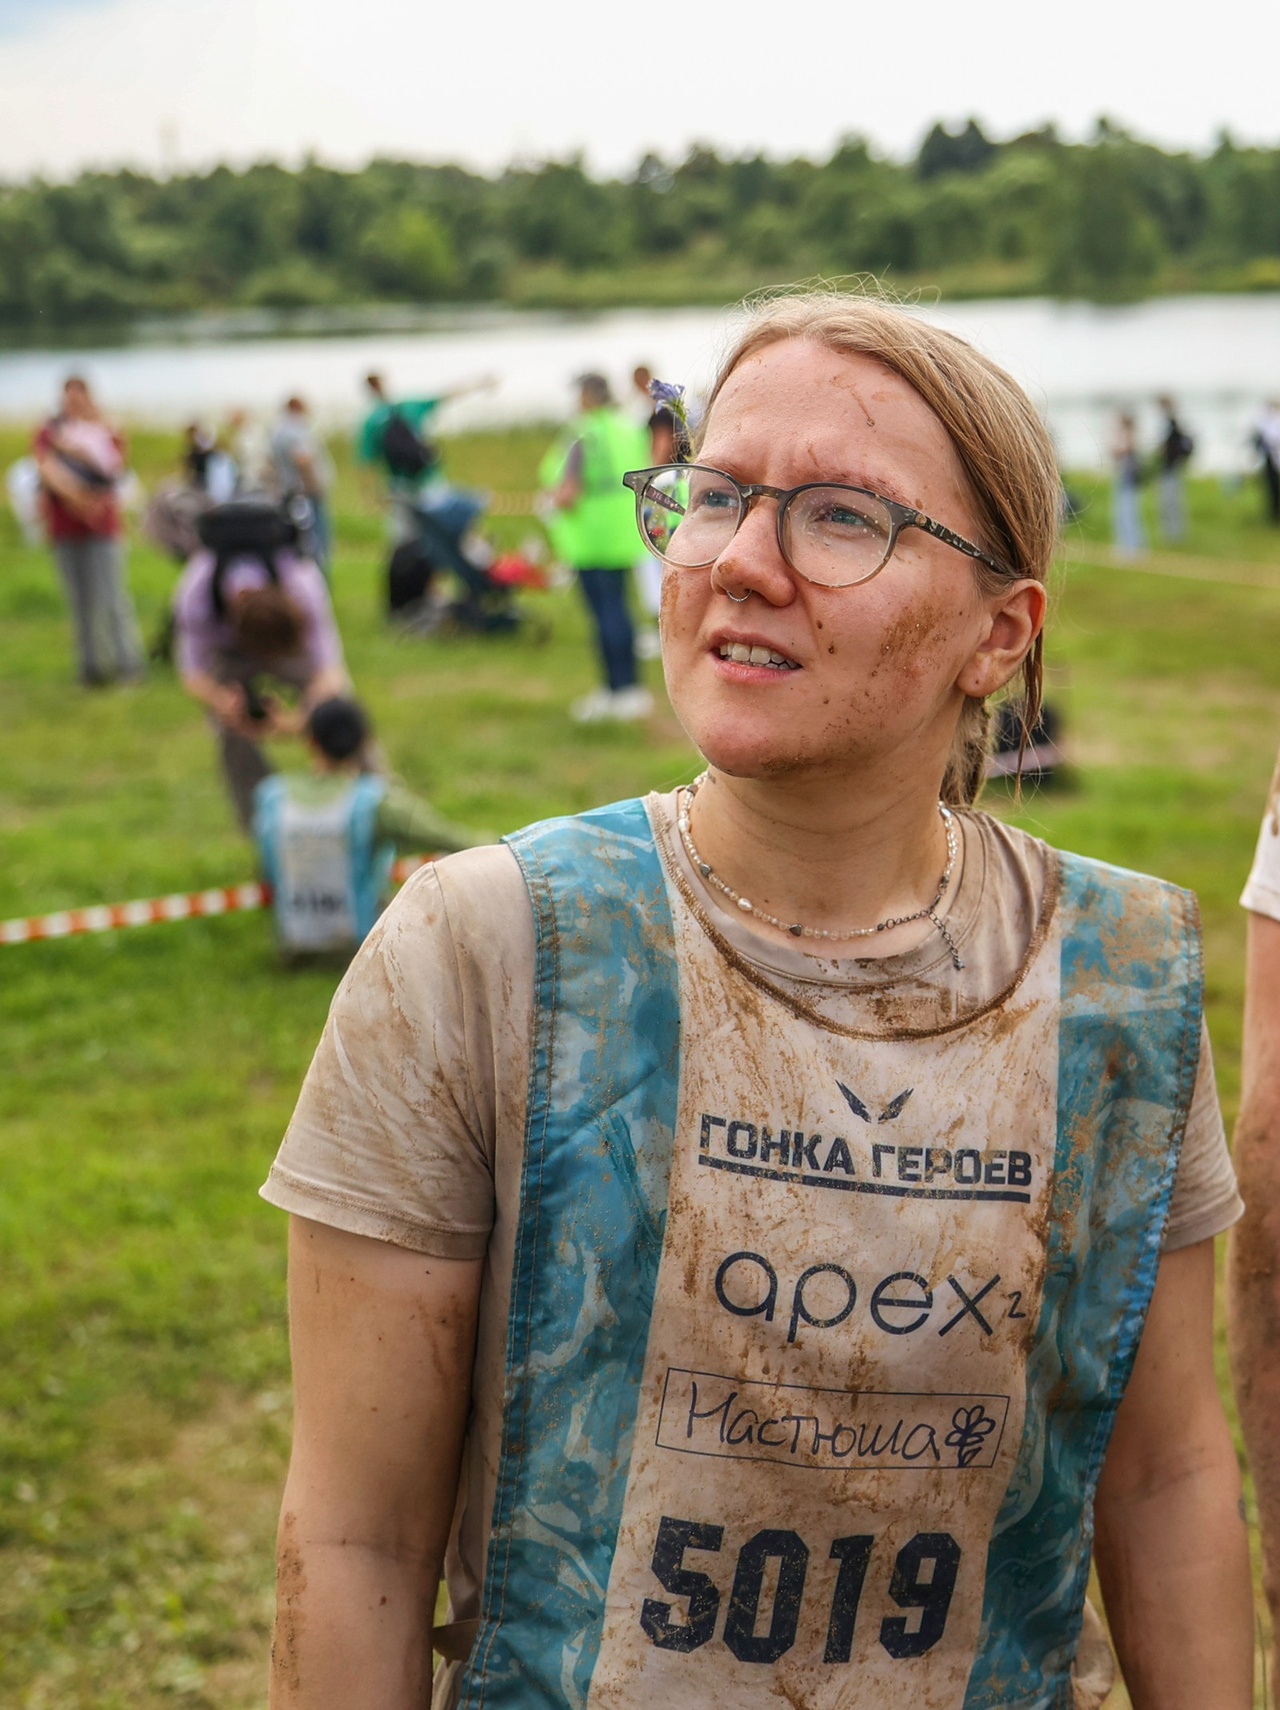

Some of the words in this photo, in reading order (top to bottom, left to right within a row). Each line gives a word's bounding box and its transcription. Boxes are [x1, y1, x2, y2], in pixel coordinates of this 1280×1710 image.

[701, 1113, 855, 1177] ГОНКА
[871, 1142, 1033, 1188] ГЕРОЕВ
[715, 1251, 1001, 1343] apex
[686, 1381, 941, 1462] Настюша
[640, 1516, 962, 1665] 5019
